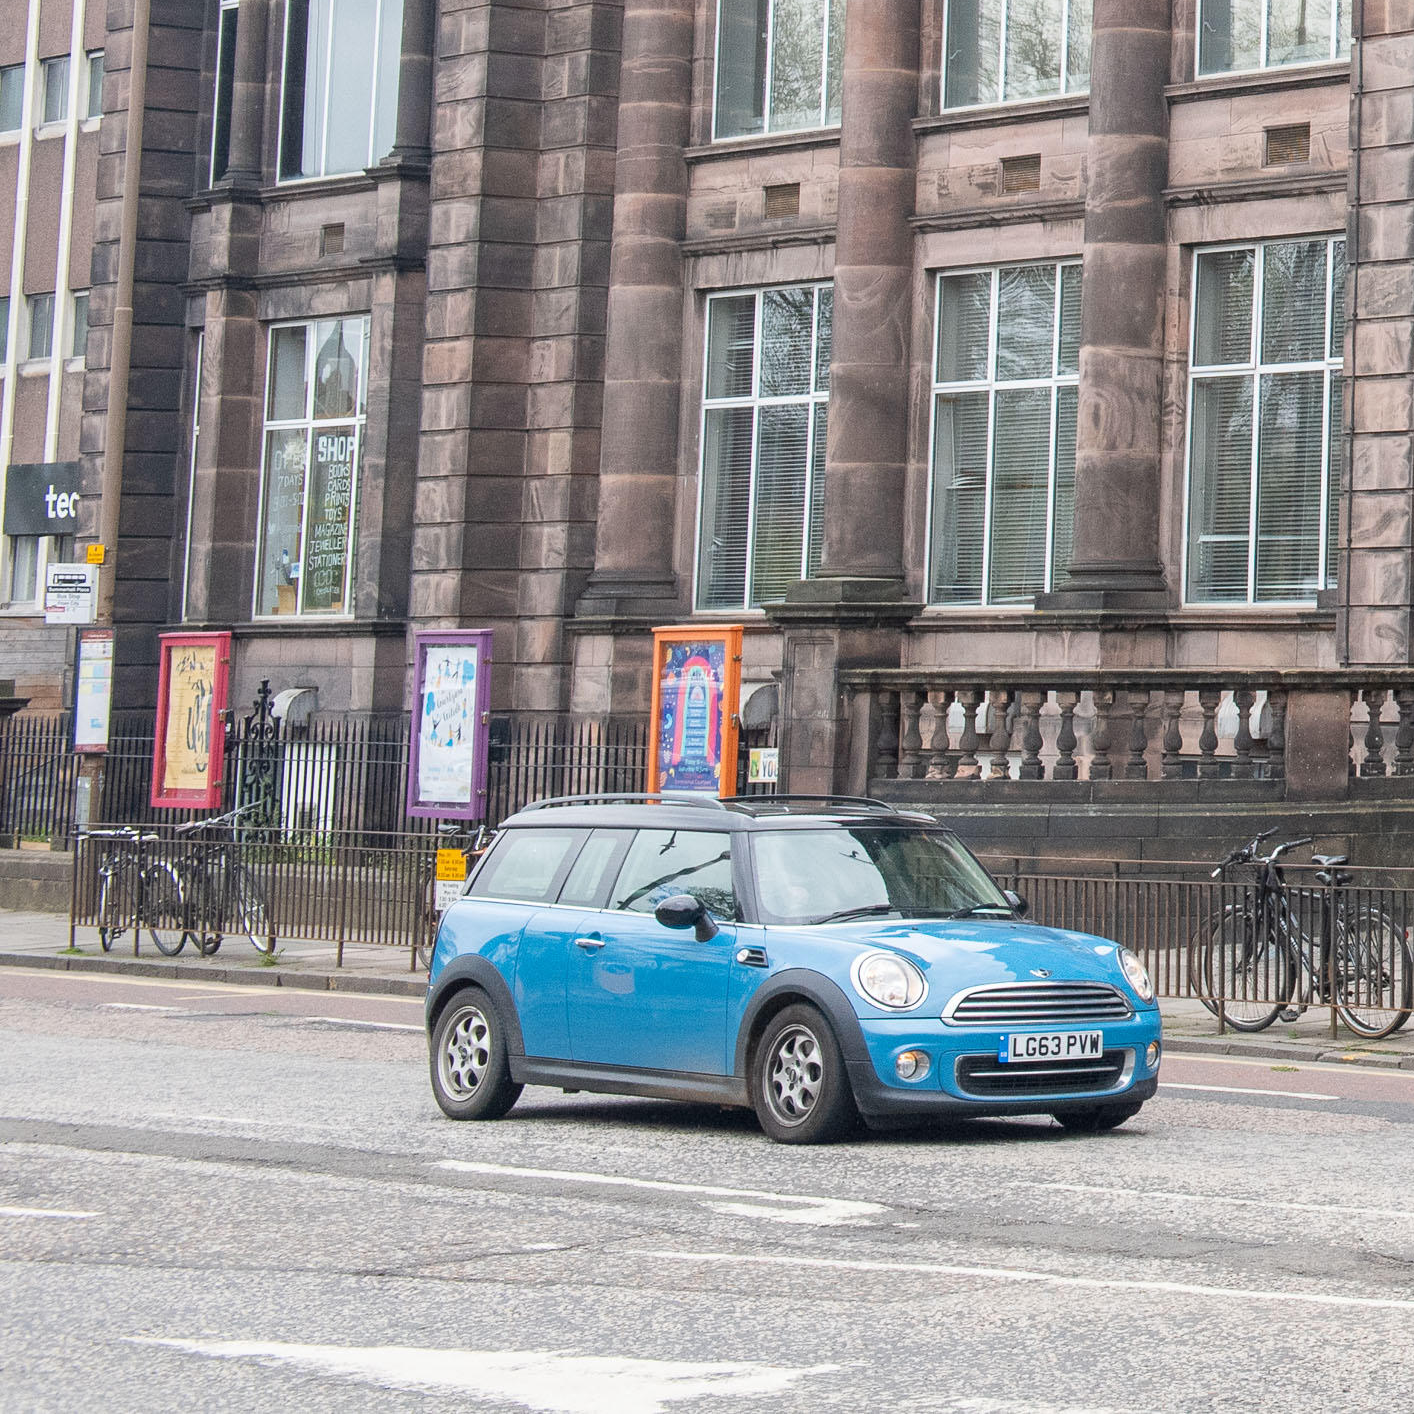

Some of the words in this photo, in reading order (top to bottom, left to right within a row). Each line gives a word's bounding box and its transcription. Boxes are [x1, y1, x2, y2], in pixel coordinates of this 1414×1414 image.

[318, 436, 355, 462] SHOP
[328, 464, 350, 479] BOOKS
[284, 474, 303, 486] DAYS
[328, 479, 350, 492] CARDS
[325, 491, 350, 507] PRINTS
[325, 507, 343, 521] TOYS
[1013, 1036, 1062, 1058] LG63
[1066, 1034, 1100, 1055] PVW
